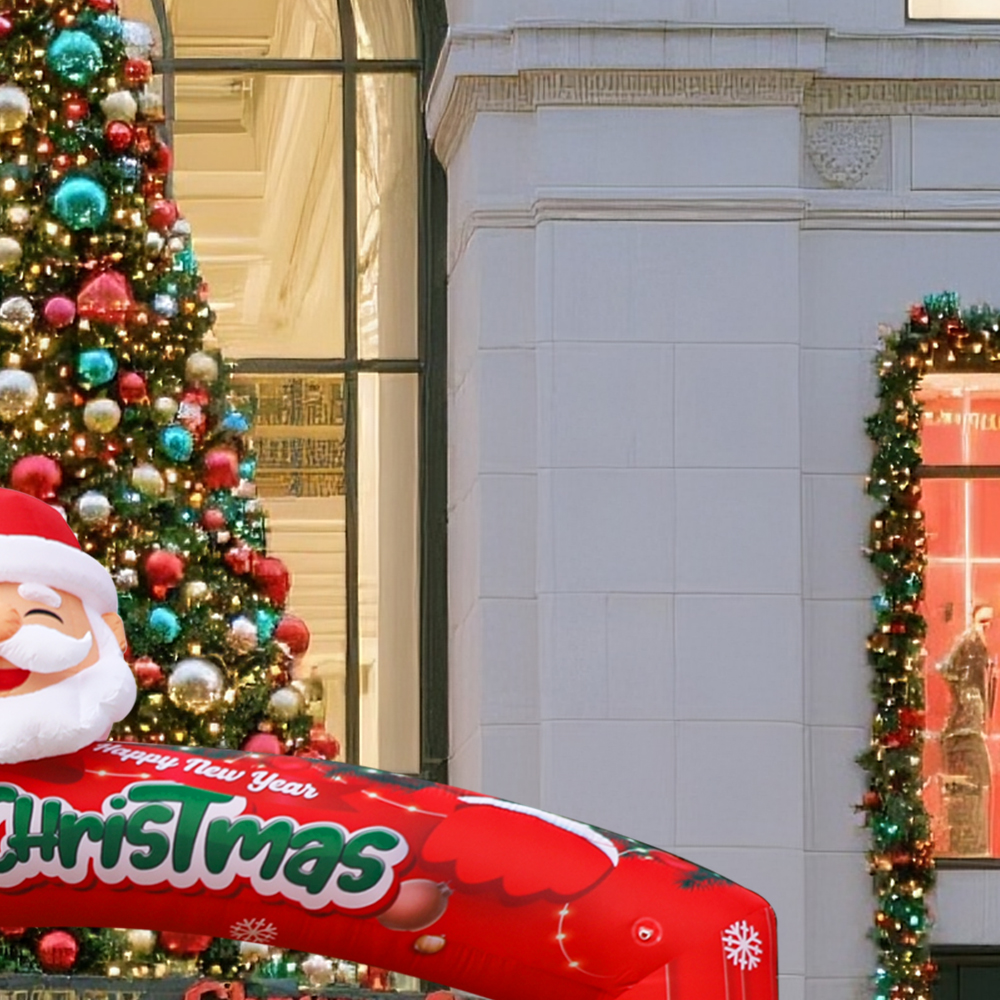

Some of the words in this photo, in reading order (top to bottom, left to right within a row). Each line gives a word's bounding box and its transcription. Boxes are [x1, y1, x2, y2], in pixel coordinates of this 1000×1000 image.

[93, 743, 179, 770] Happy
[183, 757, 246, 782] New
[247, 770, 319, 799] Year
